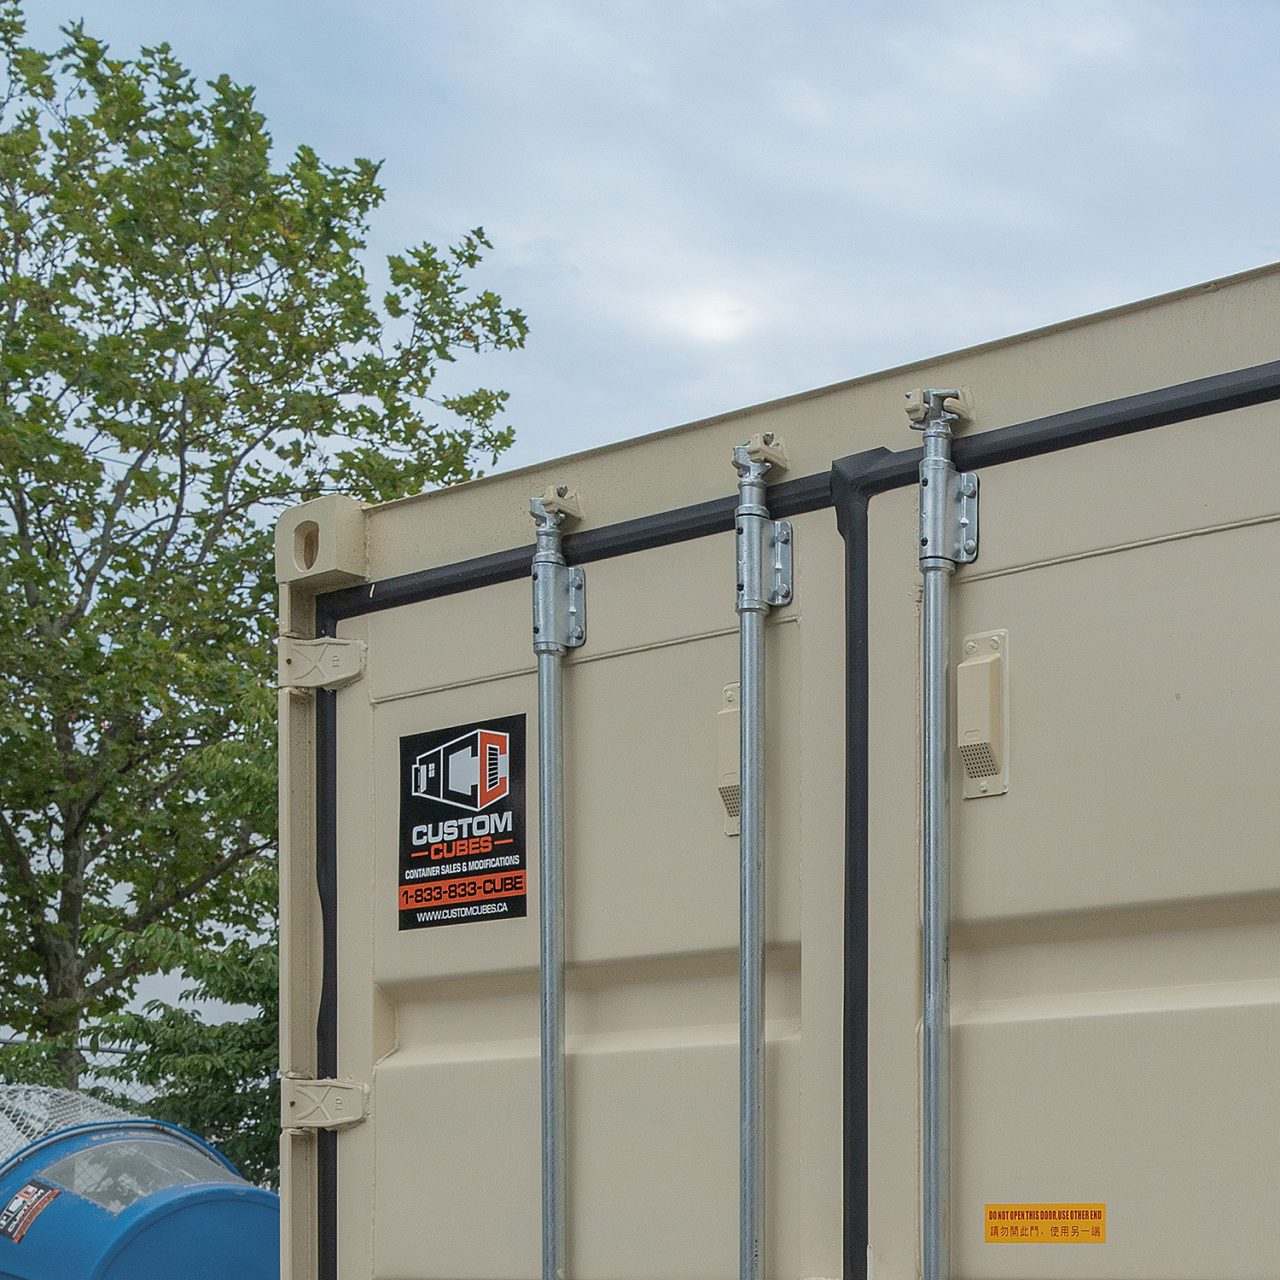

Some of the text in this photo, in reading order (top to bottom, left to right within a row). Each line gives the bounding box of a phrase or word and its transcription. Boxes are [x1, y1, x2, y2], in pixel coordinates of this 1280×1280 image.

[412, 811, 513, 846] CUSTOM
[430, 836, 493, 860] CUBES
[405, 855, 520, 880] CONTAINER SALES & MODIFICATIONS
[402, 875, 523, 905] 1-833-833-CUBE
[416, 902, 508, 923] WWW.CUSTOMCUBES.CA
[989, 1210, 997, 1221] DO
[998, 1210, 1009, 1221] NOT
[1010, 1210, 1024, 1221] OPEN
[1026, 1210, 1040, 1221] THIS
[1058, 1210, 1069, 1221] USE
[1070, 1210, 1089, 1221] OTHER
[1090, 1210, 1102, 1221] END
